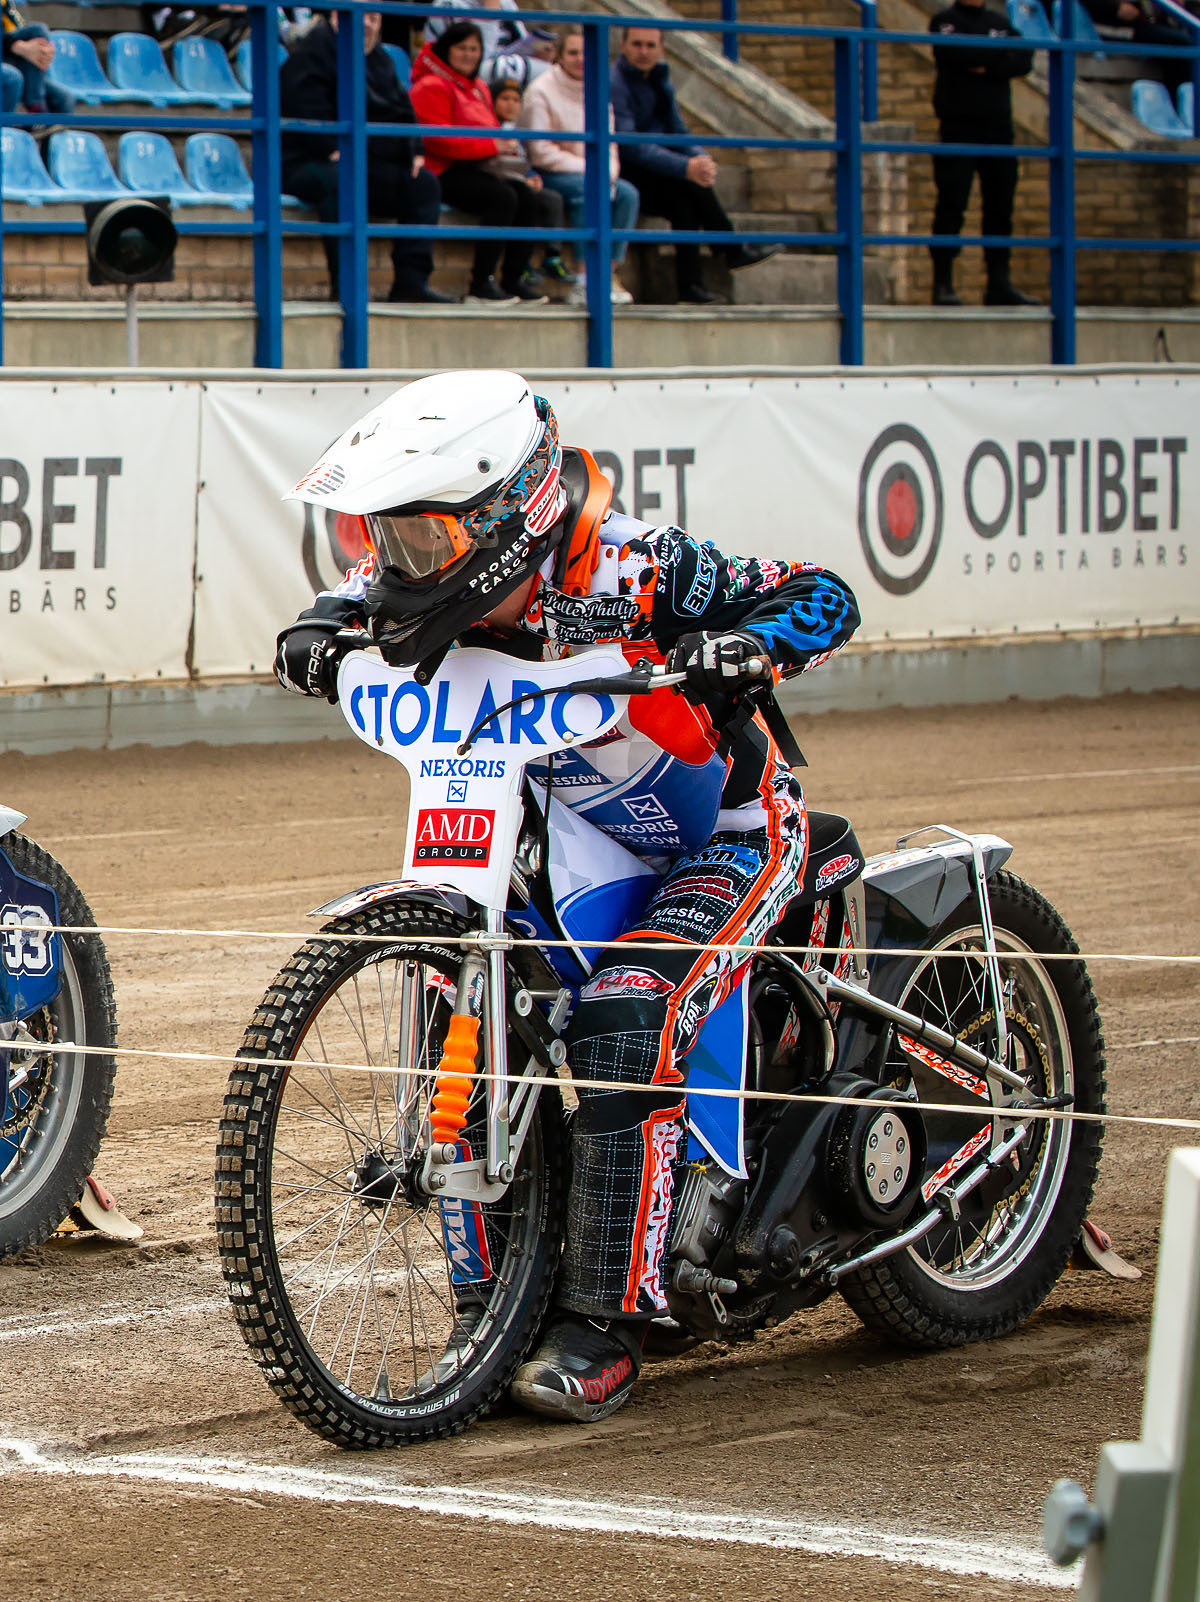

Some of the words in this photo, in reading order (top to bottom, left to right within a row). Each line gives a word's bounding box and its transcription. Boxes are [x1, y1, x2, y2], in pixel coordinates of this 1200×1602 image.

[963, 437, 1188, 539] OPTIBET
[468, 531, 530, 588] PROMET
[481, 546, 530, 594] CARGO
[962, 548, 1088, 576] SPORTA
[1113, 539, 1188, 569] BĀRS
[9, 581, 117, 614] BĀRS
[543, 593, 581, 617] Palle
[584, 601, 639, 621] Phillip
[350, 678, 615, 746] STOLARO
[420, 759, 506, 778] NEXORIS
[417, 813, 492, 843] AMD
[418, 847, 484, 858] GROUP
[652, 907, 715, 925] Mester
[656, 916, 714, 936] Autoværksted
[594, 975, 675, 994] KARGER
[621, 986, 657, 998] Racing
